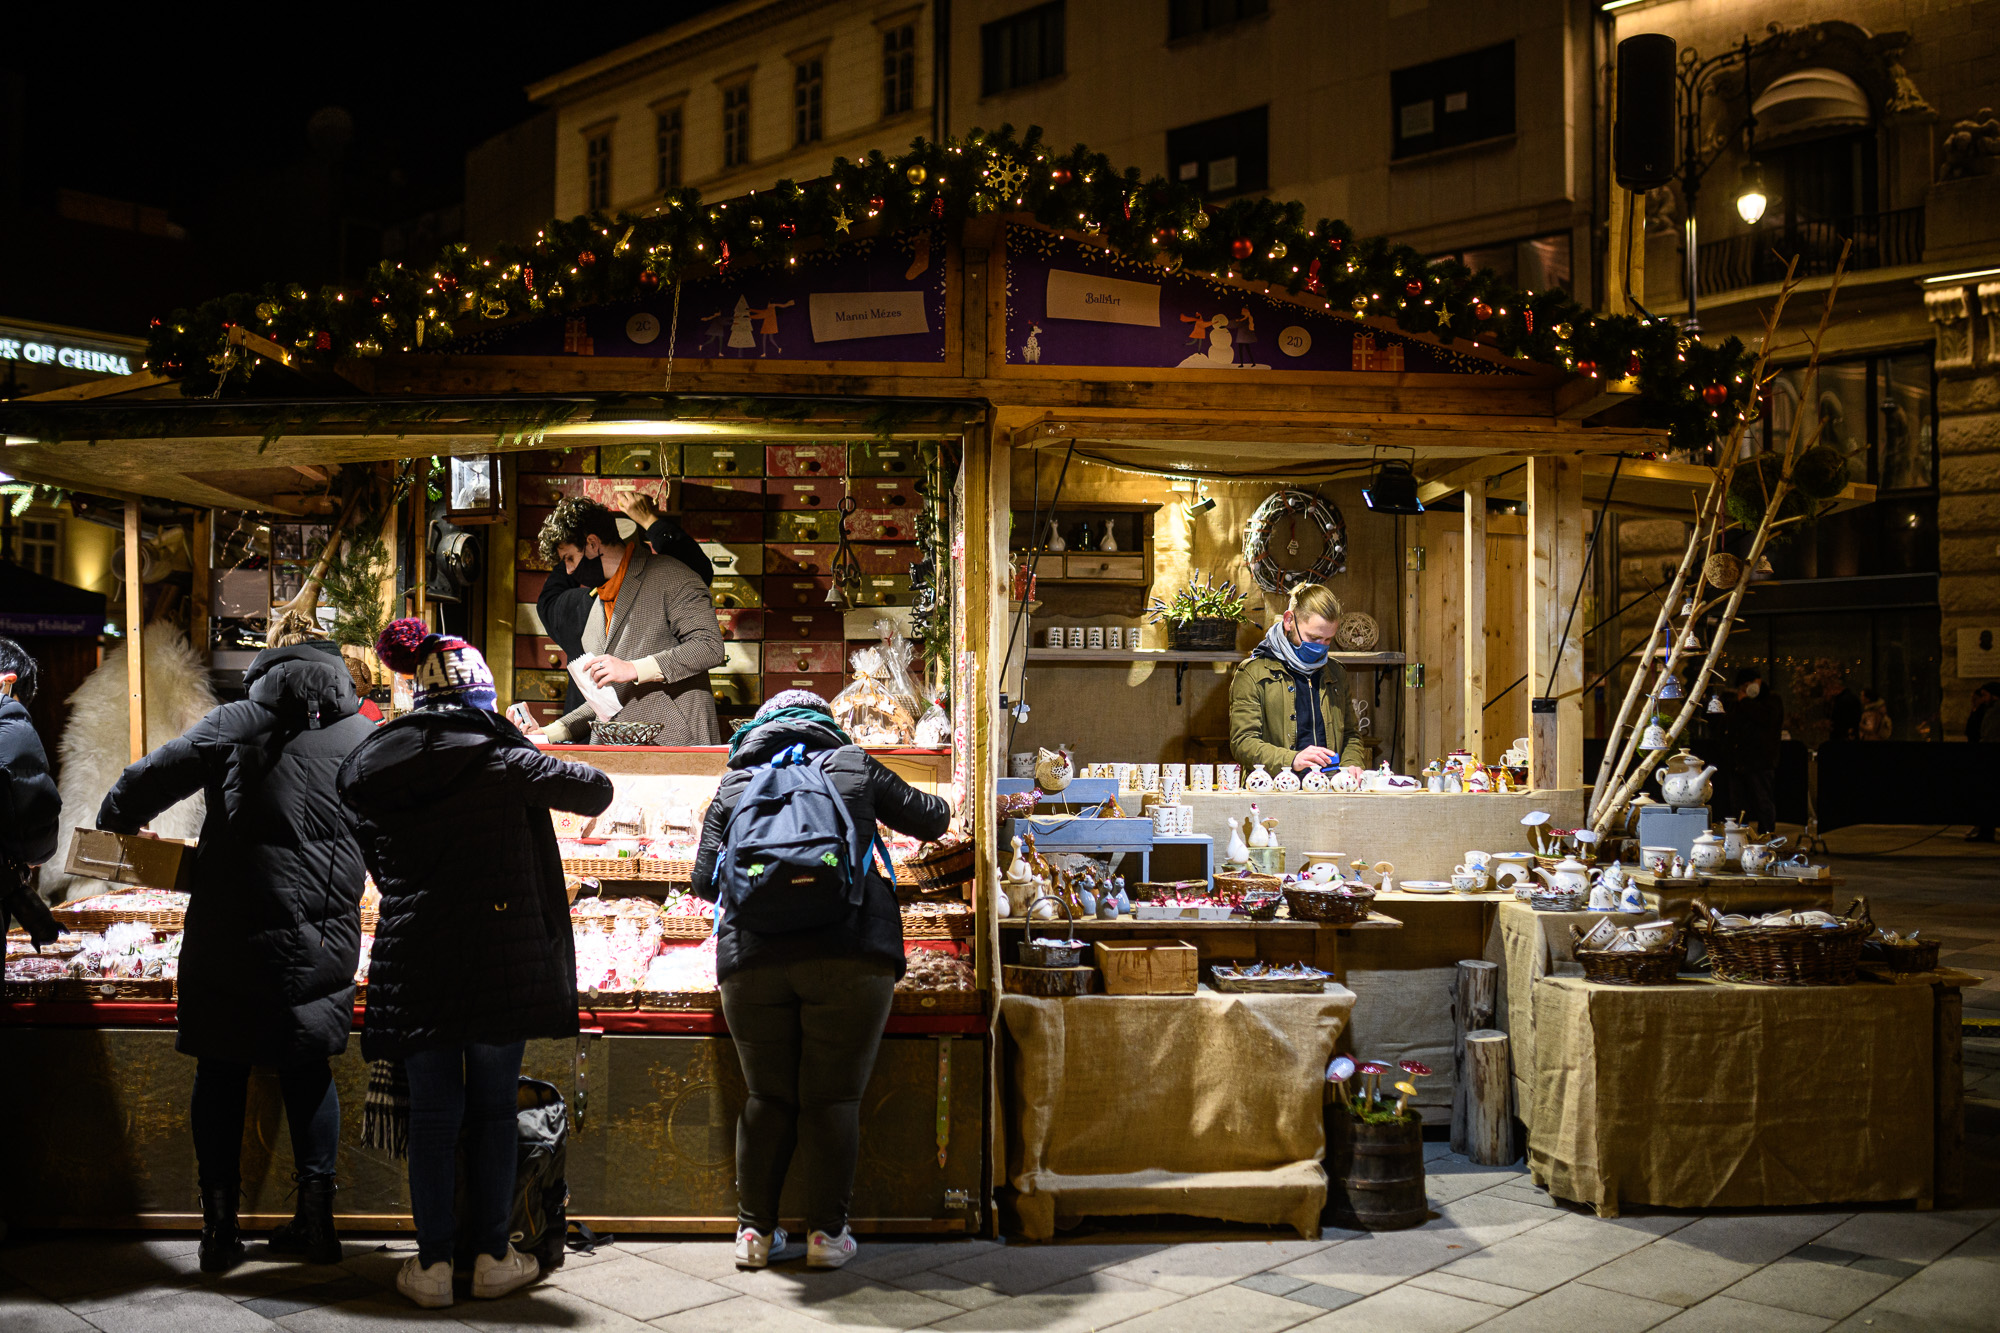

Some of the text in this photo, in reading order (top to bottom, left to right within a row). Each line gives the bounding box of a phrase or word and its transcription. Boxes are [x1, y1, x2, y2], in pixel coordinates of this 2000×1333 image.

[1085, 292, 1121, 306] BallArt
[835, 308, 902, 322] Manni Mézes
[635, 320, 651, 331] 2C
[1287, 335, 1303, 348] 2D
[0, 338, 133, 376] K OF CHINA
